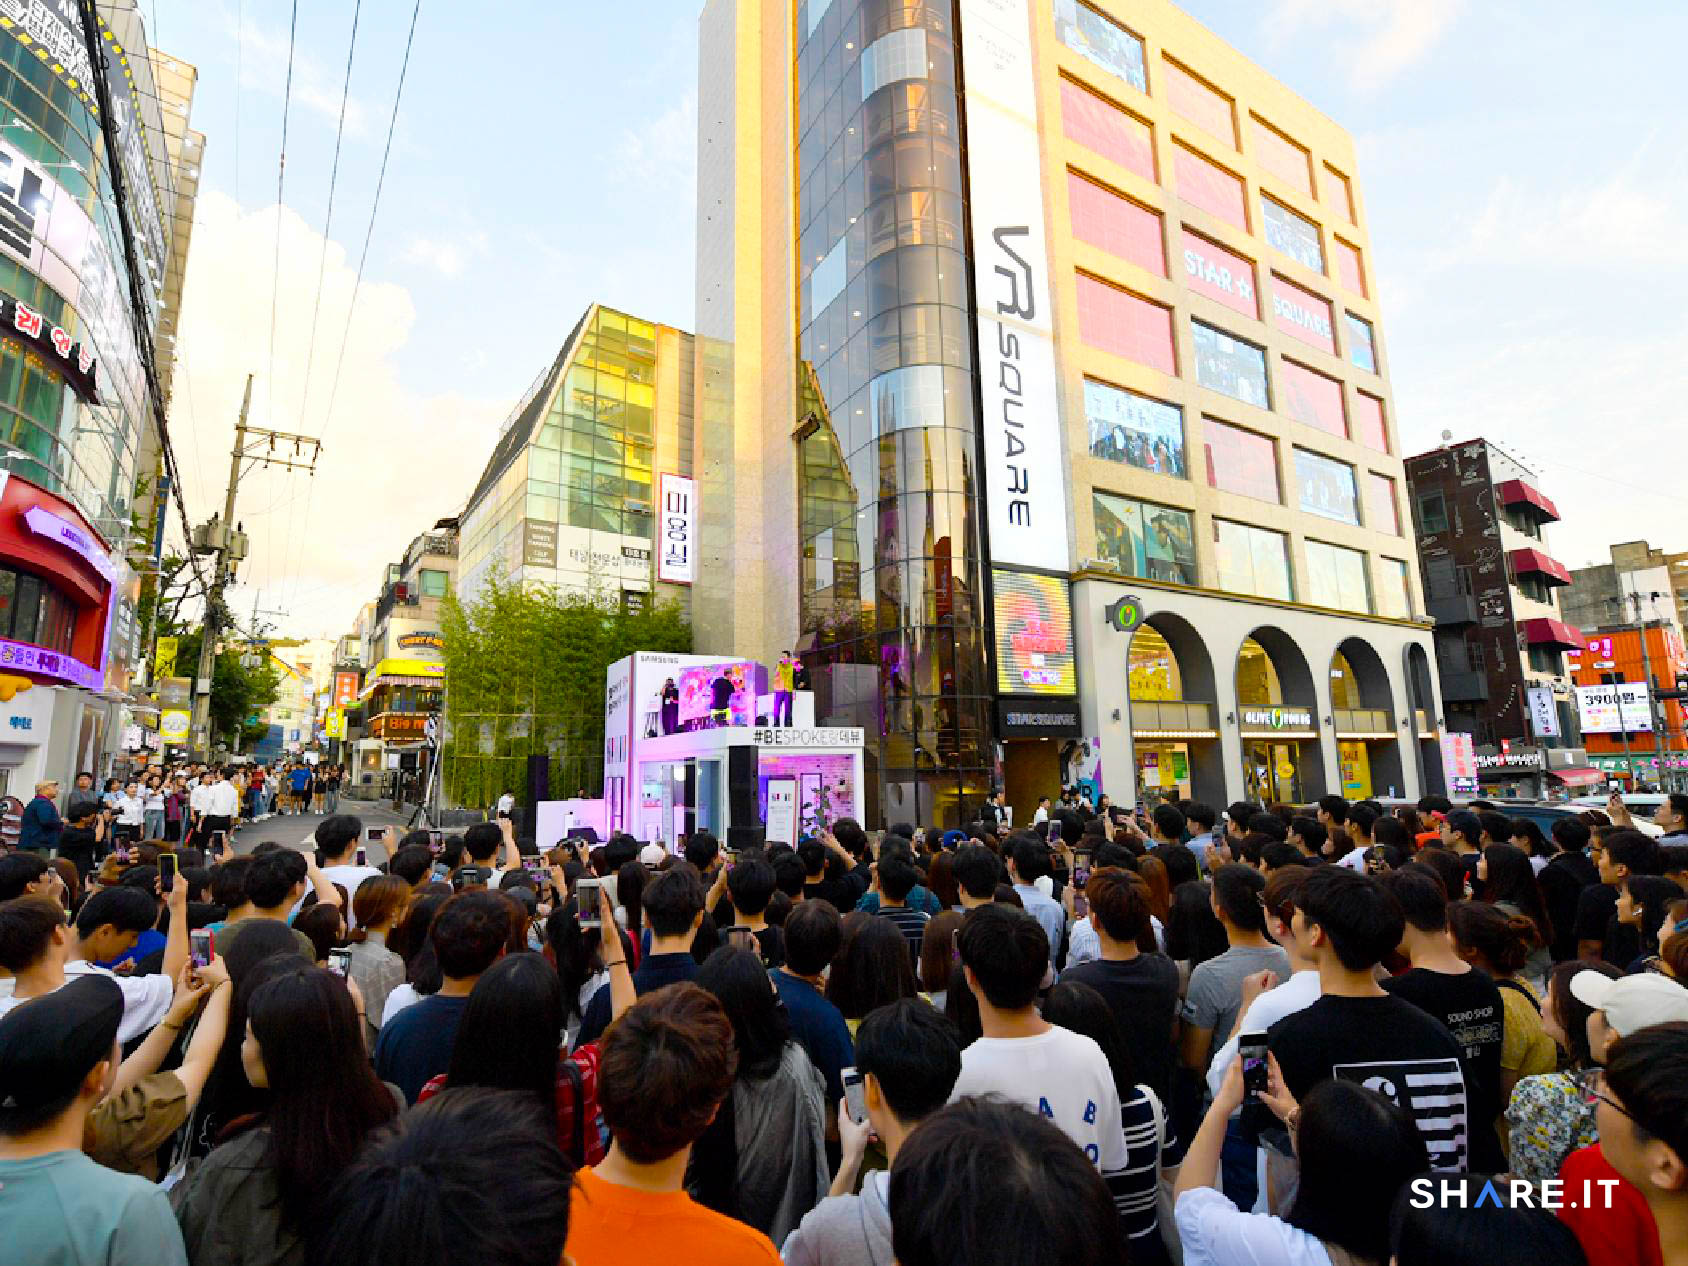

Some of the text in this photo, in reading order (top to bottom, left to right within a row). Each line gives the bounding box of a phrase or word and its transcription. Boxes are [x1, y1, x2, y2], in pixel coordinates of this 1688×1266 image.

[1184, 250, 1234, 295] STAR
[1273, 295, 1332, 341] SQUARE
[992, 225, 1035, 527] VR SQUARE
[666, 491, 688, 567] 미용실
[640, 655, 679, 665] SAMSUNG
[1245, 711, 1271, 724] OLIVE
[1448, 1010, 1473, 1024] SOUND
[1083, 1099, 1098, 1126] B
